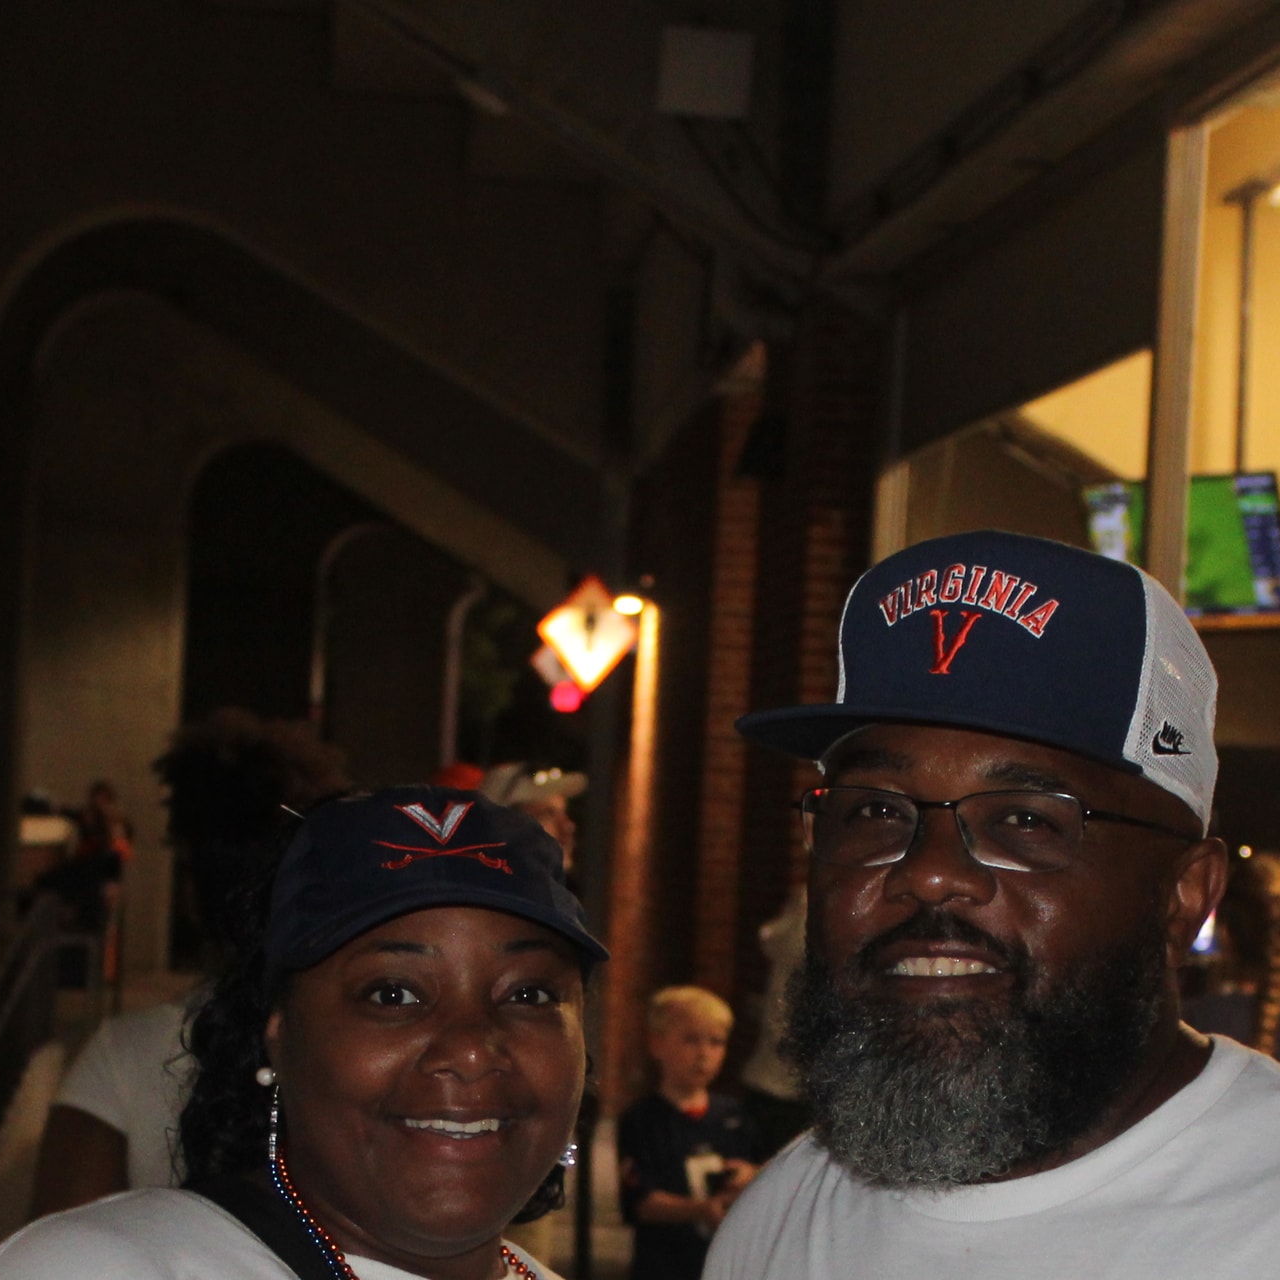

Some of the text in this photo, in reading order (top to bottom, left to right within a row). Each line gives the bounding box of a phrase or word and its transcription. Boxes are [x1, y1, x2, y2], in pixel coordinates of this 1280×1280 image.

[878, 562, 1061, 639] VIRGINIA
[928, 608, 982, 675] V
[392, 800, 475, 846] V
